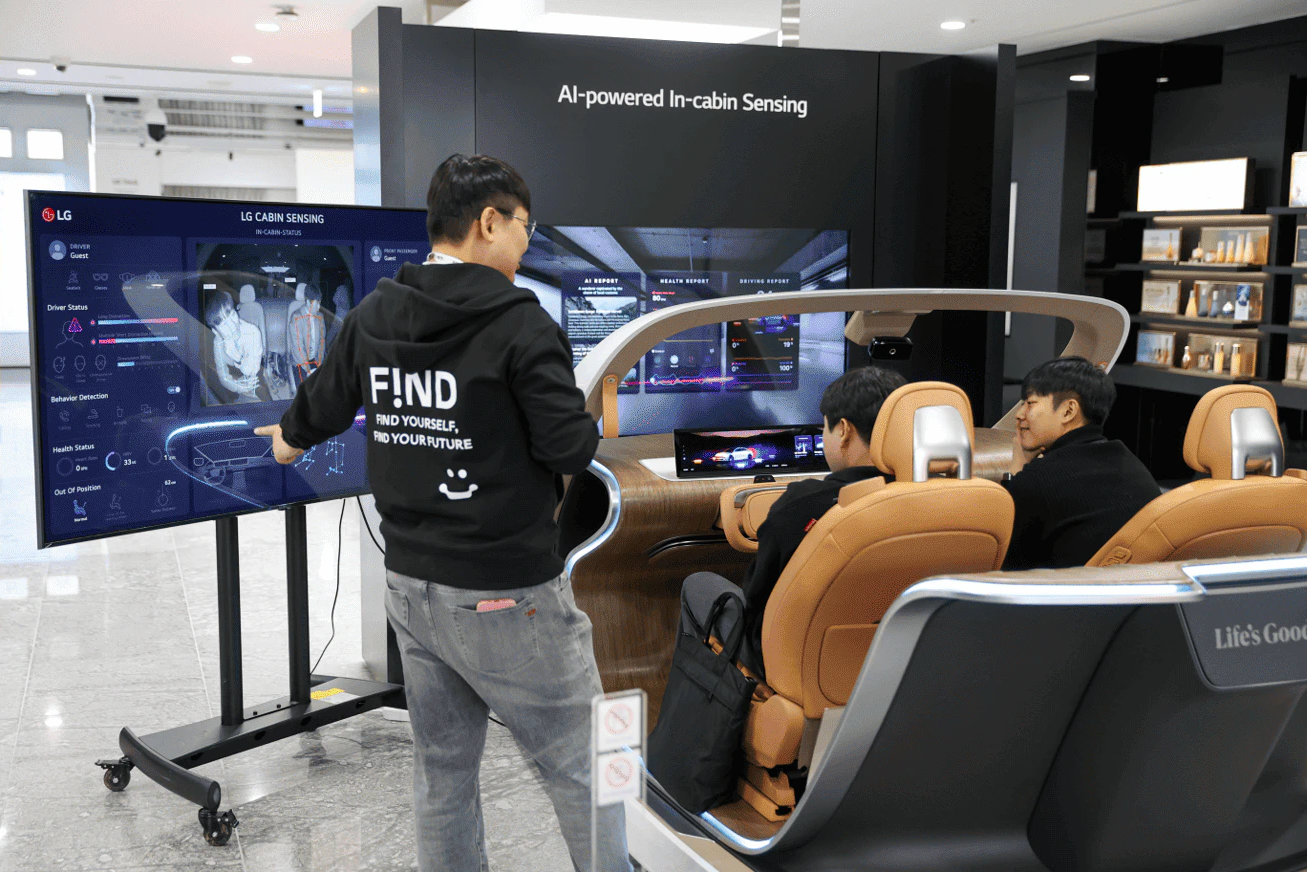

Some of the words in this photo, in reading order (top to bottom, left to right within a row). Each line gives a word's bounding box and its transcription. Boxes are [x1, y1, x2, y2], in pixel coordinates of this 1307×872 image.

[558, 84, 664, 109] AI-powered
[669, 89, 737, 110] In-cabin
[742, 93, 808, 118] Sensing
[57, 209, 72, 221] LG
[241, 211, 253, 222] LG
[255, 212, 284, 223] CABIN
[286, 213, 325, 224] SENSING
[51, 395, 78, 403] Behavior
[79, 393, 109, 401] Detection
[376, 413, 399, 426] FIND
[401, 415, 459, 434] YOURSELF,
[373, 430, 390, 444] FIND
[391, 432, 426, 446] YOUR
[427, 435, 473, 450] FUTURE
[52, 445, 74, 453] Health
[74, 443, 95, 452] Status
[54, 488, 66, 496] Out
[77, 484, 102, 493] Position
[1214, 623, 1262, 650] Life's
